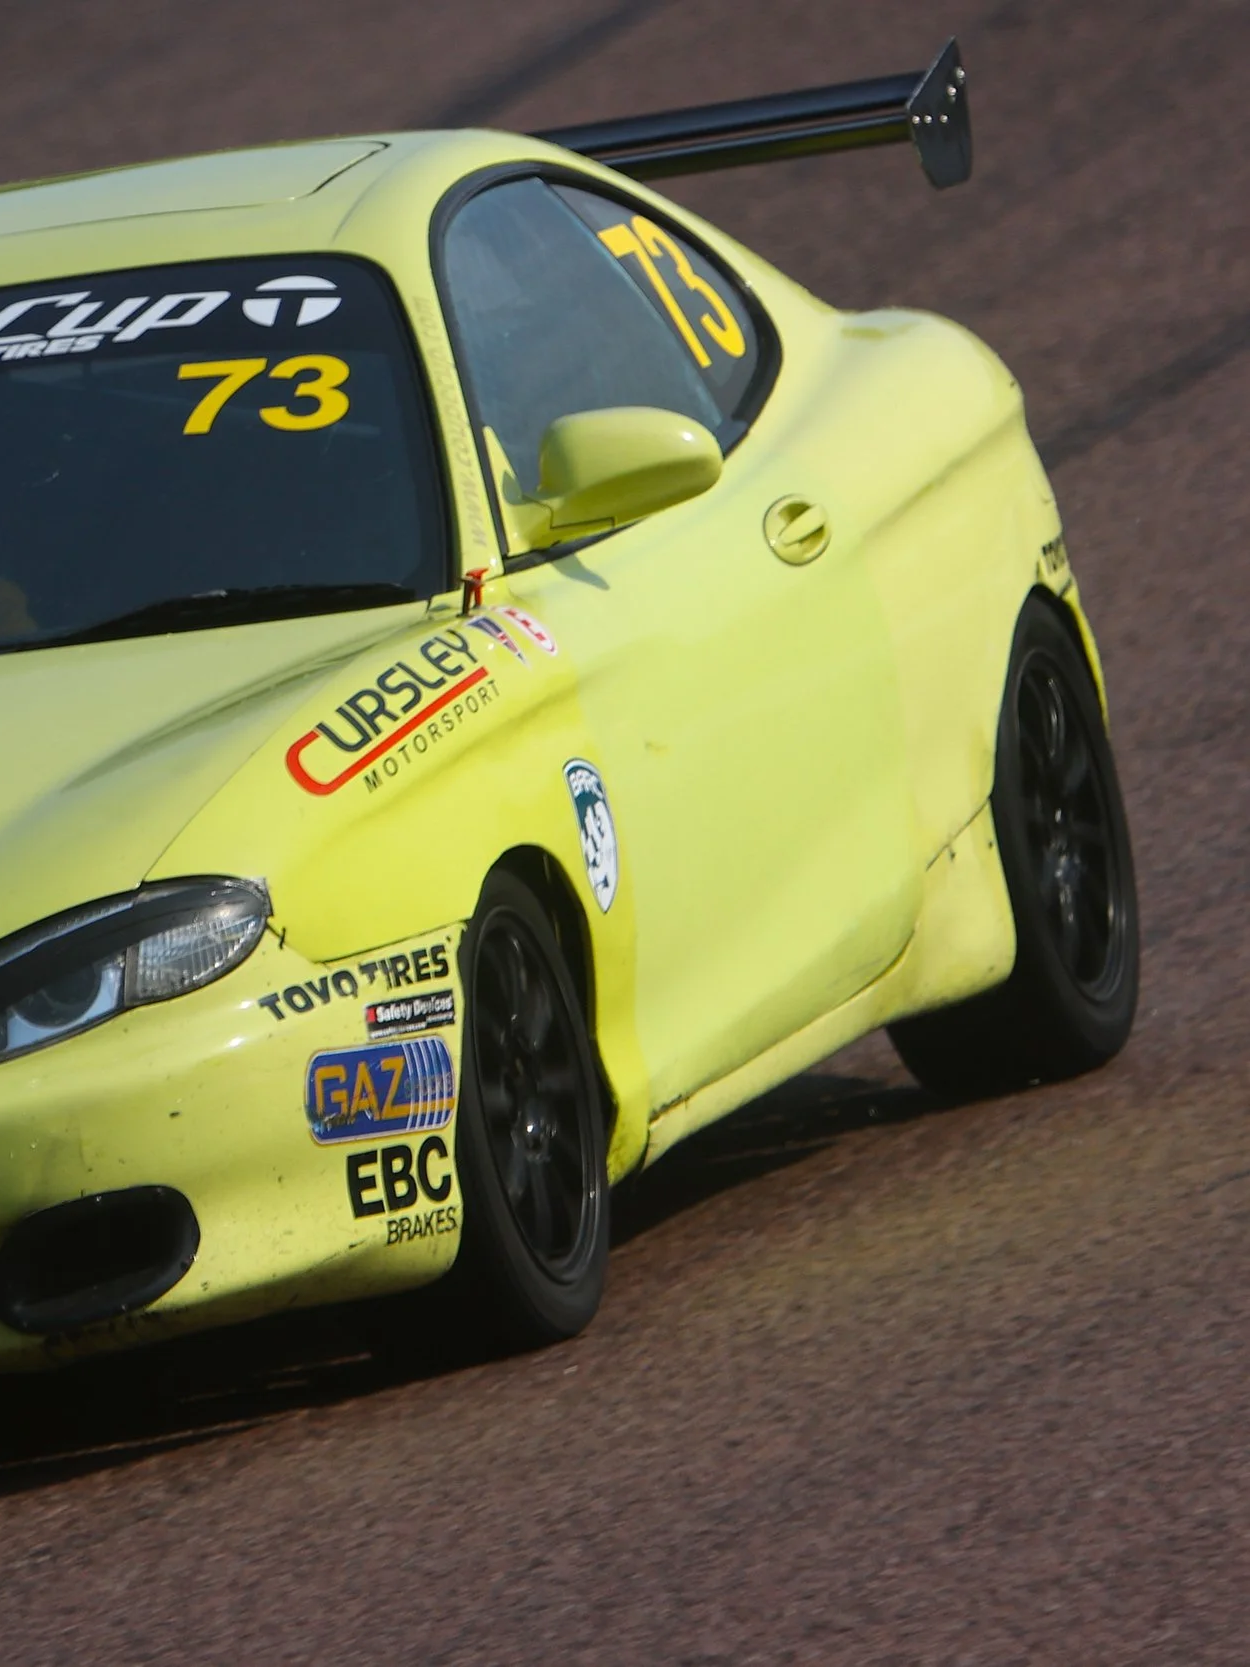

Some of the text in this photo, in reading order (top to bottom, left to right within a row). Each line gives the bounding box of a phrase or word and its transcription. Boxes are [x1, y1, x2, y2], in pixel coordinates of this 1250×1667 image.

[597, 215, 746, 368] 73
[177, 354, 350, 435] 73
[286, 629, 488, 796] CURSLEY
[363, 679, 500, 793] MOTORSPORT
[258, 945, 449, 1021] TOYO TIRES
[376, 1002, 412, 1023] Safety
[413, 995, 453, 1016] Devices
[314, 1055, 416, 1123] GAZ
[346, 1135, 452, 1219] EBC
[387, 1206, 459, 1246] BRAKES
